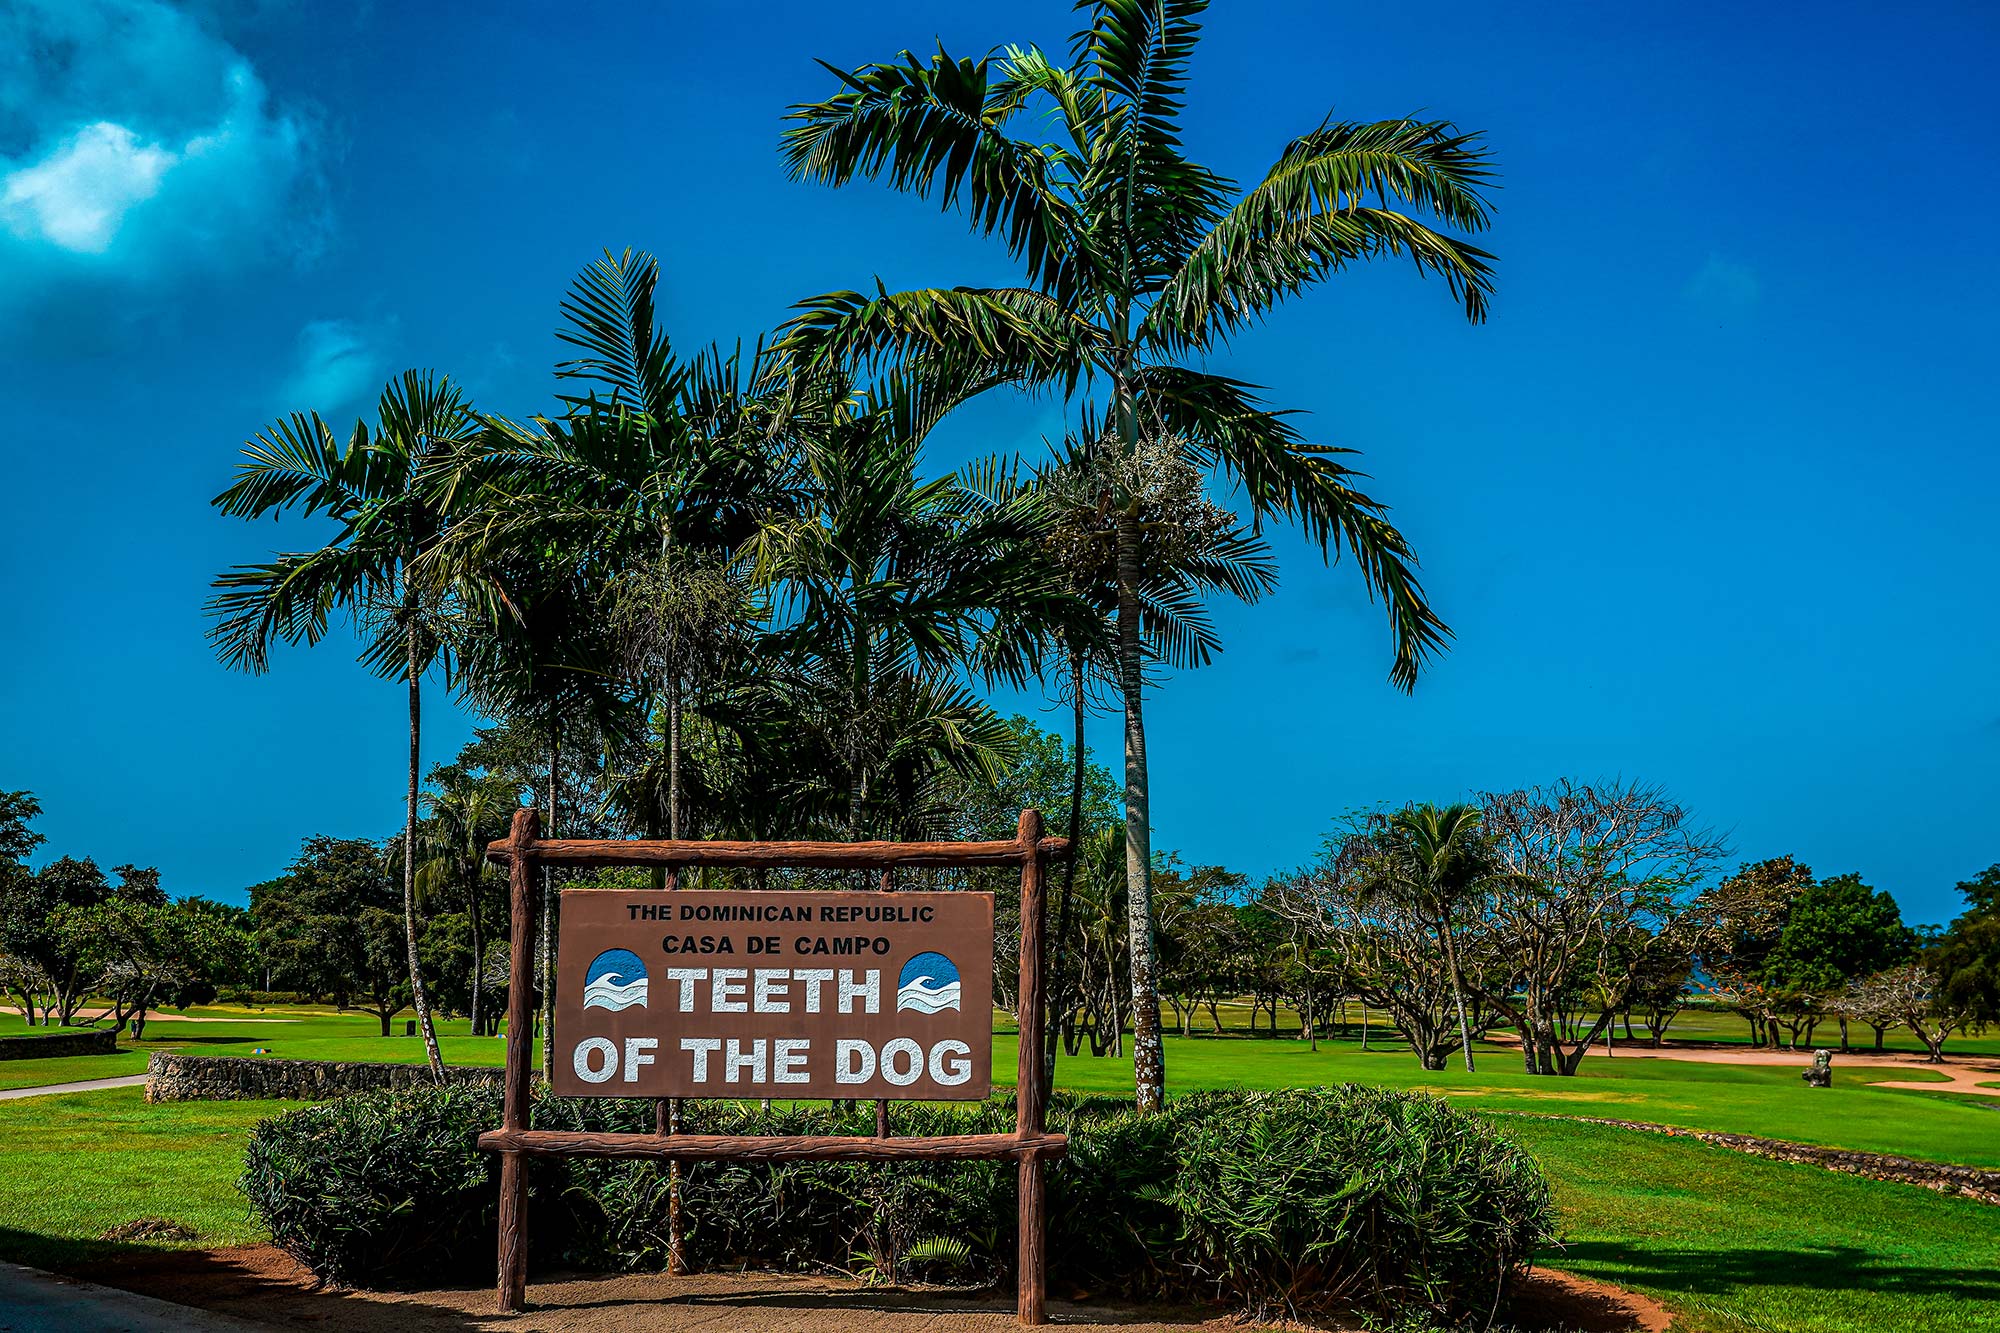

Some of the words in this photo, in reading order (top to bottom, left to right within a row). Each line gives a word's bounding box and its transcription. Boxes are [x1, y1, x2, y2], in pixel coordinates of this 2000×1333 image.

[626, 904, 672, 921] THE
[679, 904, 812, 922] DOMINICAN
[820, 905, 934, 923] REPUBLIC
[662, 935, 734, 954] CASA
[747, 936, 781, 954] DE
[794, 936, 891, 955] CAMPO
[667, 968, 880, 1014] TEETH
[573, 1037, 659, 1084] OF
[680, 1037, 810, 1084] THE
[835, 1037, 972, 1086] DOG
